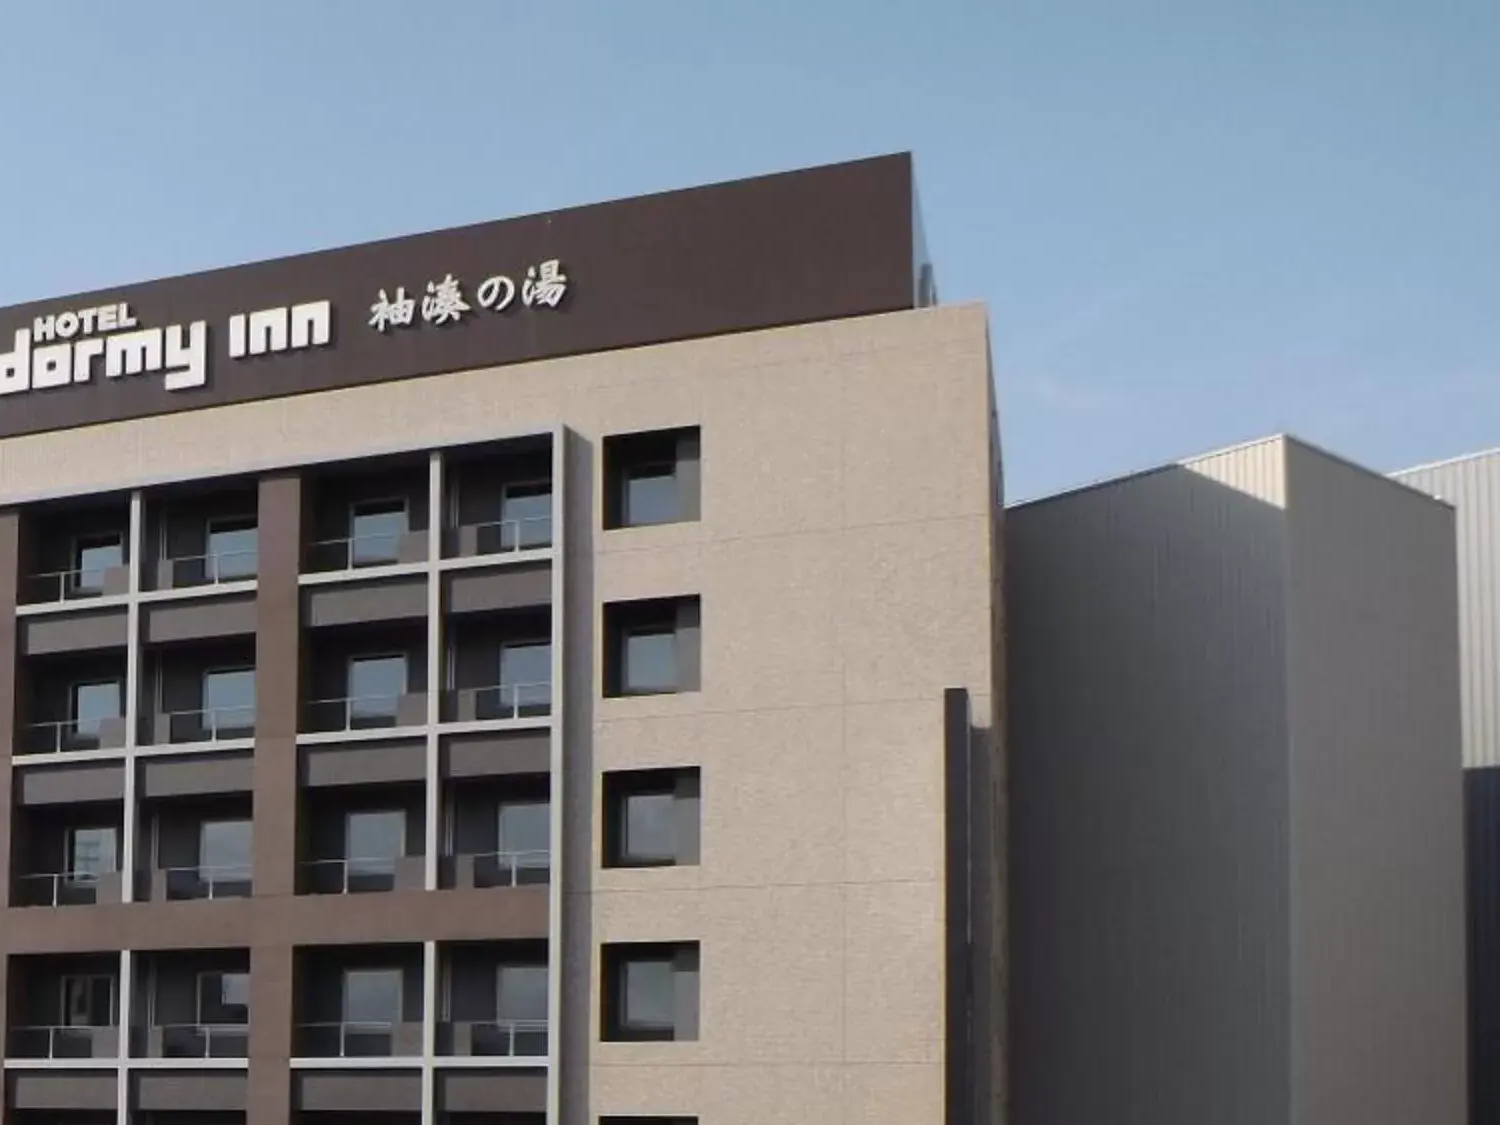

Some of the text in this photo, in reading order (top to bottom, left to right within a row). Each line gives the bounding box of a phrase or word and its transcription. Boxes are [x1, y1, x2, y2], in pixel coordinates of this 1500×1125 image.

[34, 302, 137, 342] HOTEL
[368, 259, 568, 332] 袖湊の湯
